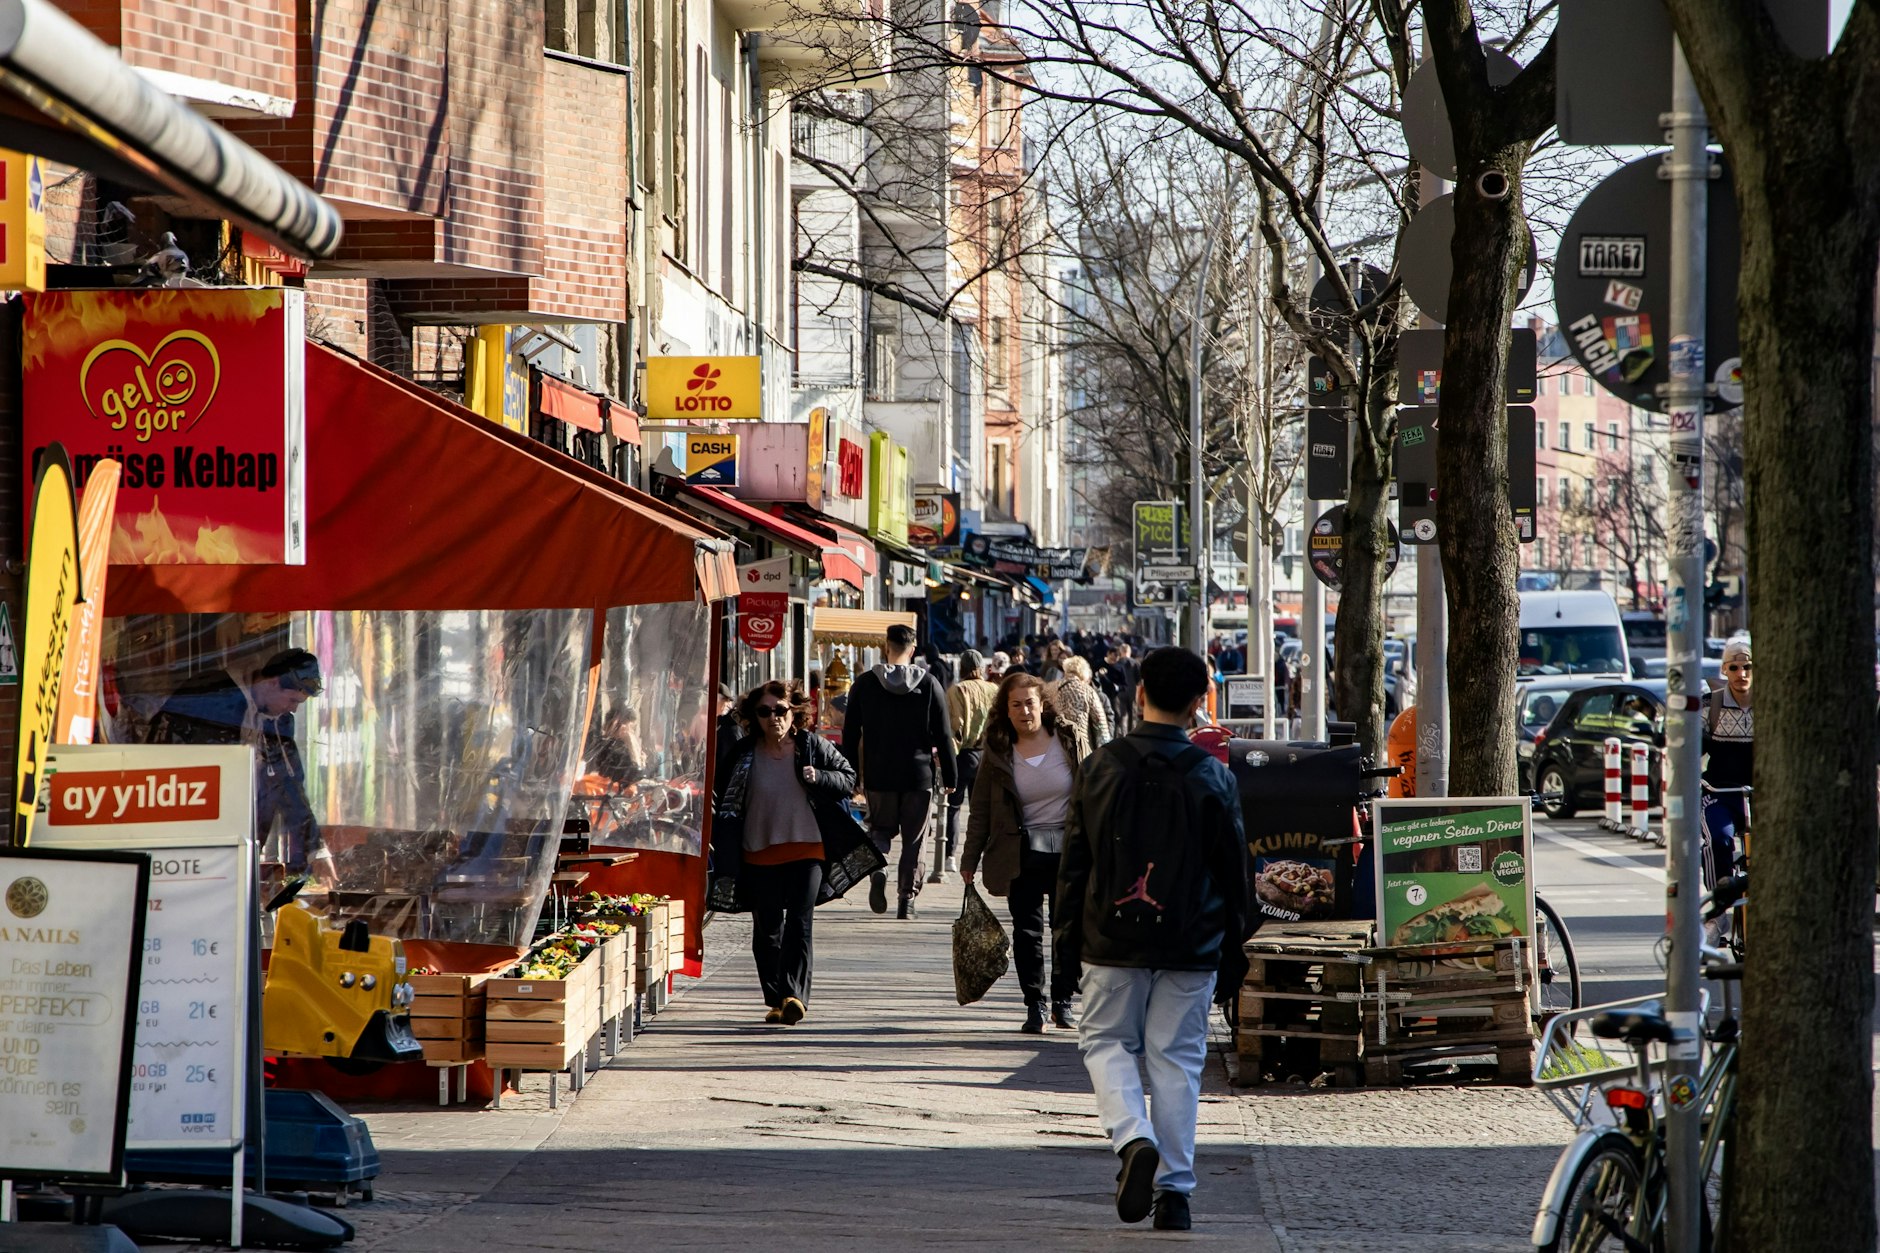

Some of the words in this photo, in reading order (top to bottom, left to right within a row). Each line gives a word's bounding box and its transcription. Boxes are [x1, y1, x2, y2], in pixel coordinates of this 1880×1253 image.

[1568, 313, 1619, 376] FACH
[102, 364, 154, 430] gel
[675, 396, 732, 411] LOTTO
[135, 401, 186, 442] gör
[691, 443, 731, 454] CASH
[174, 446, 277, 491] Kebap
[763, 572, 781, 581] dpd
[746, 597, 780, 608] Pickup
[36, 547, 71, 712] Western
[63, 785, 106, 819] ay
[112, 774, 207, 818] yıldız
[1393, 833, 1441, 848] veganen
[1444, 825, 1484, 839] Seitan
[1487, 819, 1524, 833] Döner
[1497, 866, 1525, 877] VEGGIE!
[1500, 860, 1519, 868] AUCH
[1260, 904, 1301, 921] KUMPIR
[17, 928, 80, 944] NAILS
[12, 958, 41, 975] Das
[44, 960, 92, 977] Leben
[27, 980, 68, 993] immer
[1, 995, 90, 1017] PERFEKT
[140, 1000, 159, 1014] GB
[17, 1019, 55, 1034] deine
[146, 1019, 158, 1027] EU
[3, 1037, 40, 1055] UND
[62, 1081, 82, 1097] es
[133, 1083, 145, 1091] EU
